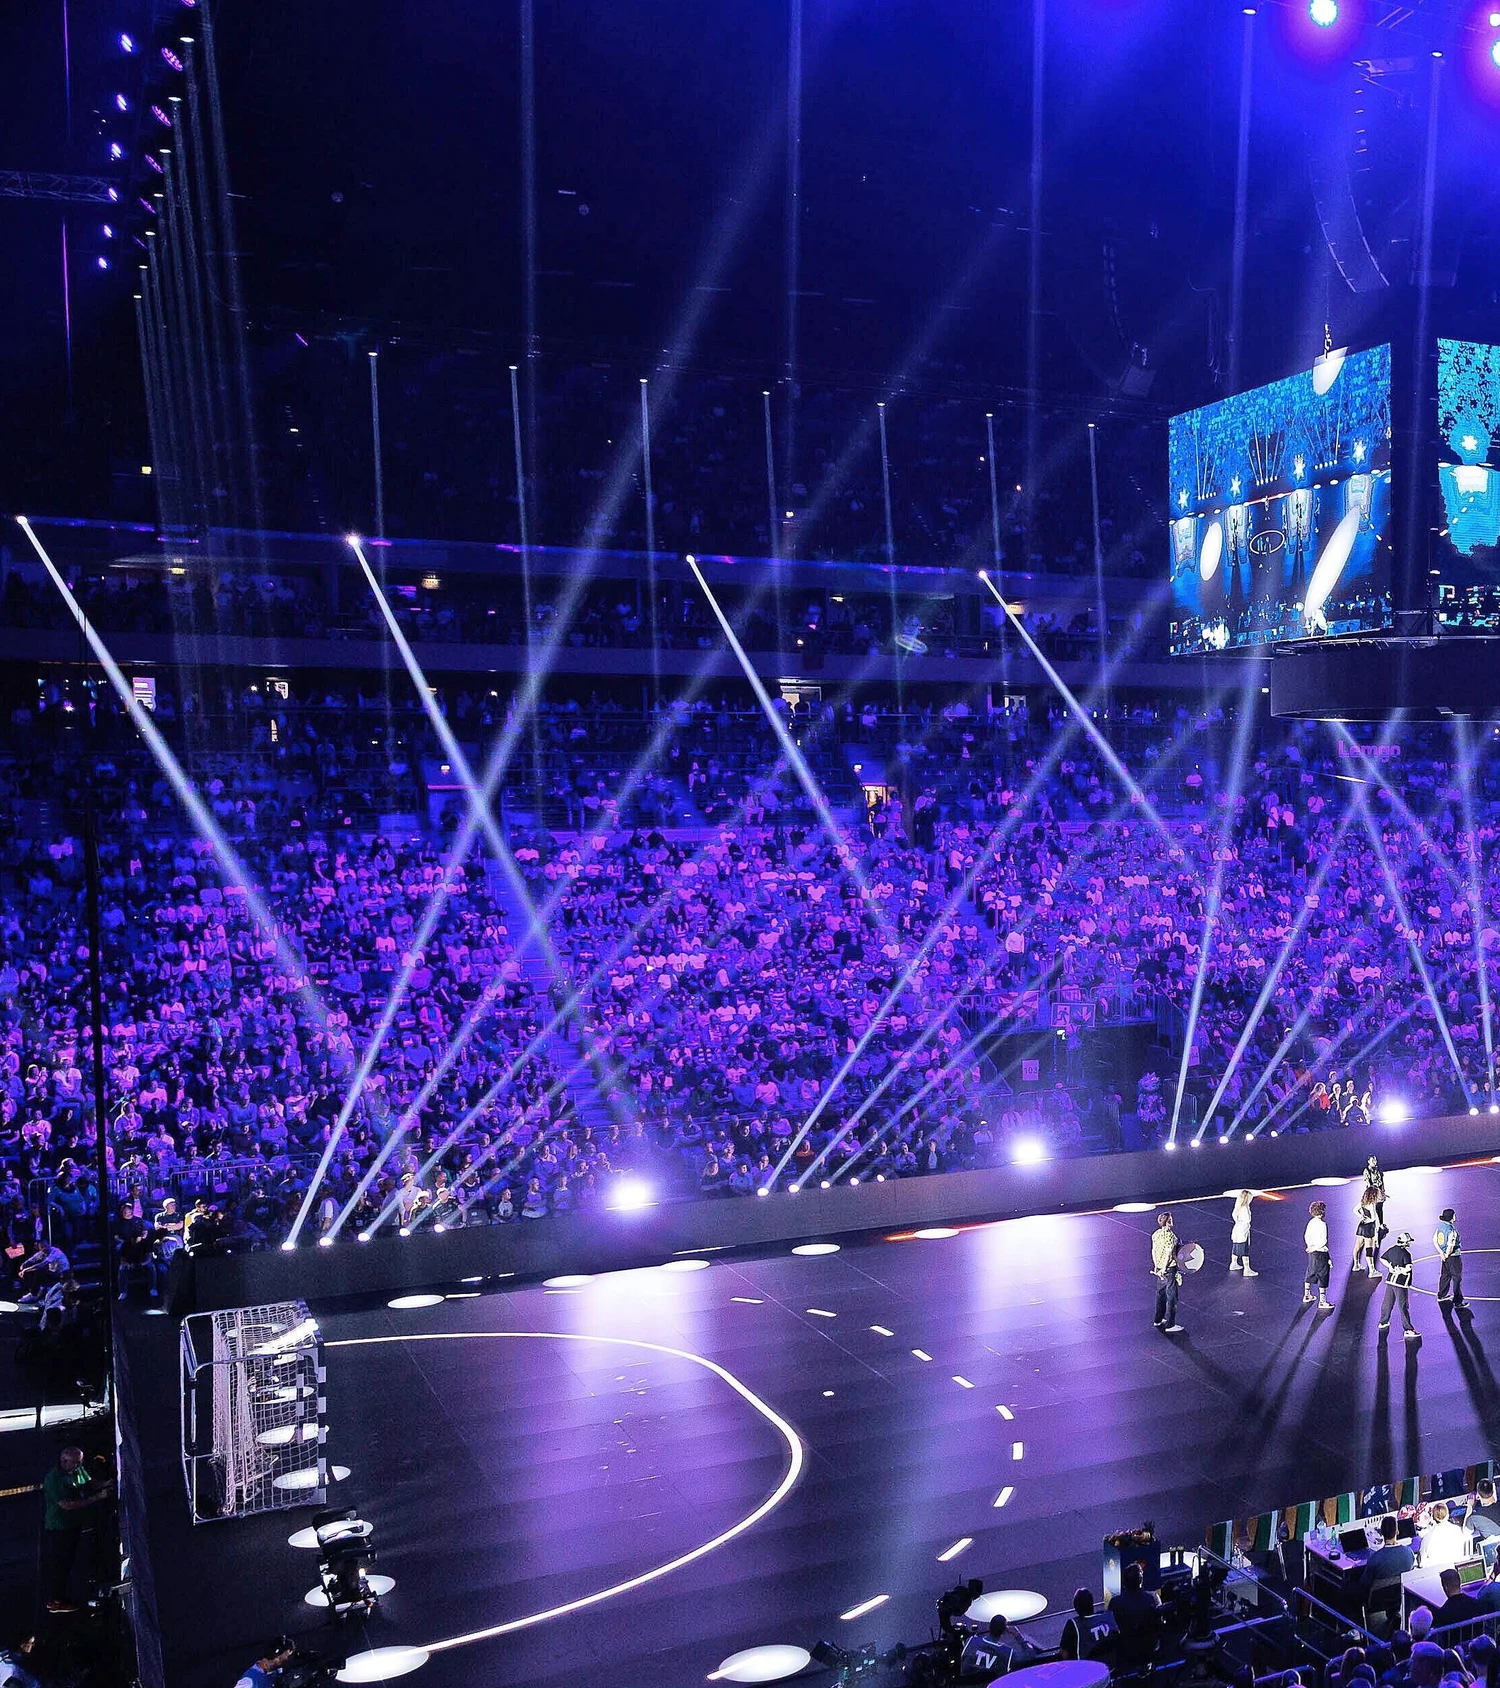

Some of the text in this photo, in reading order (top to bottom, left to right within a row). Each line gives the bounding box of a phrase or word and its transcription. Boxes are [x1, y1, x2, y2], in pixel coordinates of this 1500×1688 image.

[1338, 740, 1400, 763] Lemgo
[1090, 1624, 1110, 1641] TV
[975, 1650, 997, 1669] TV
